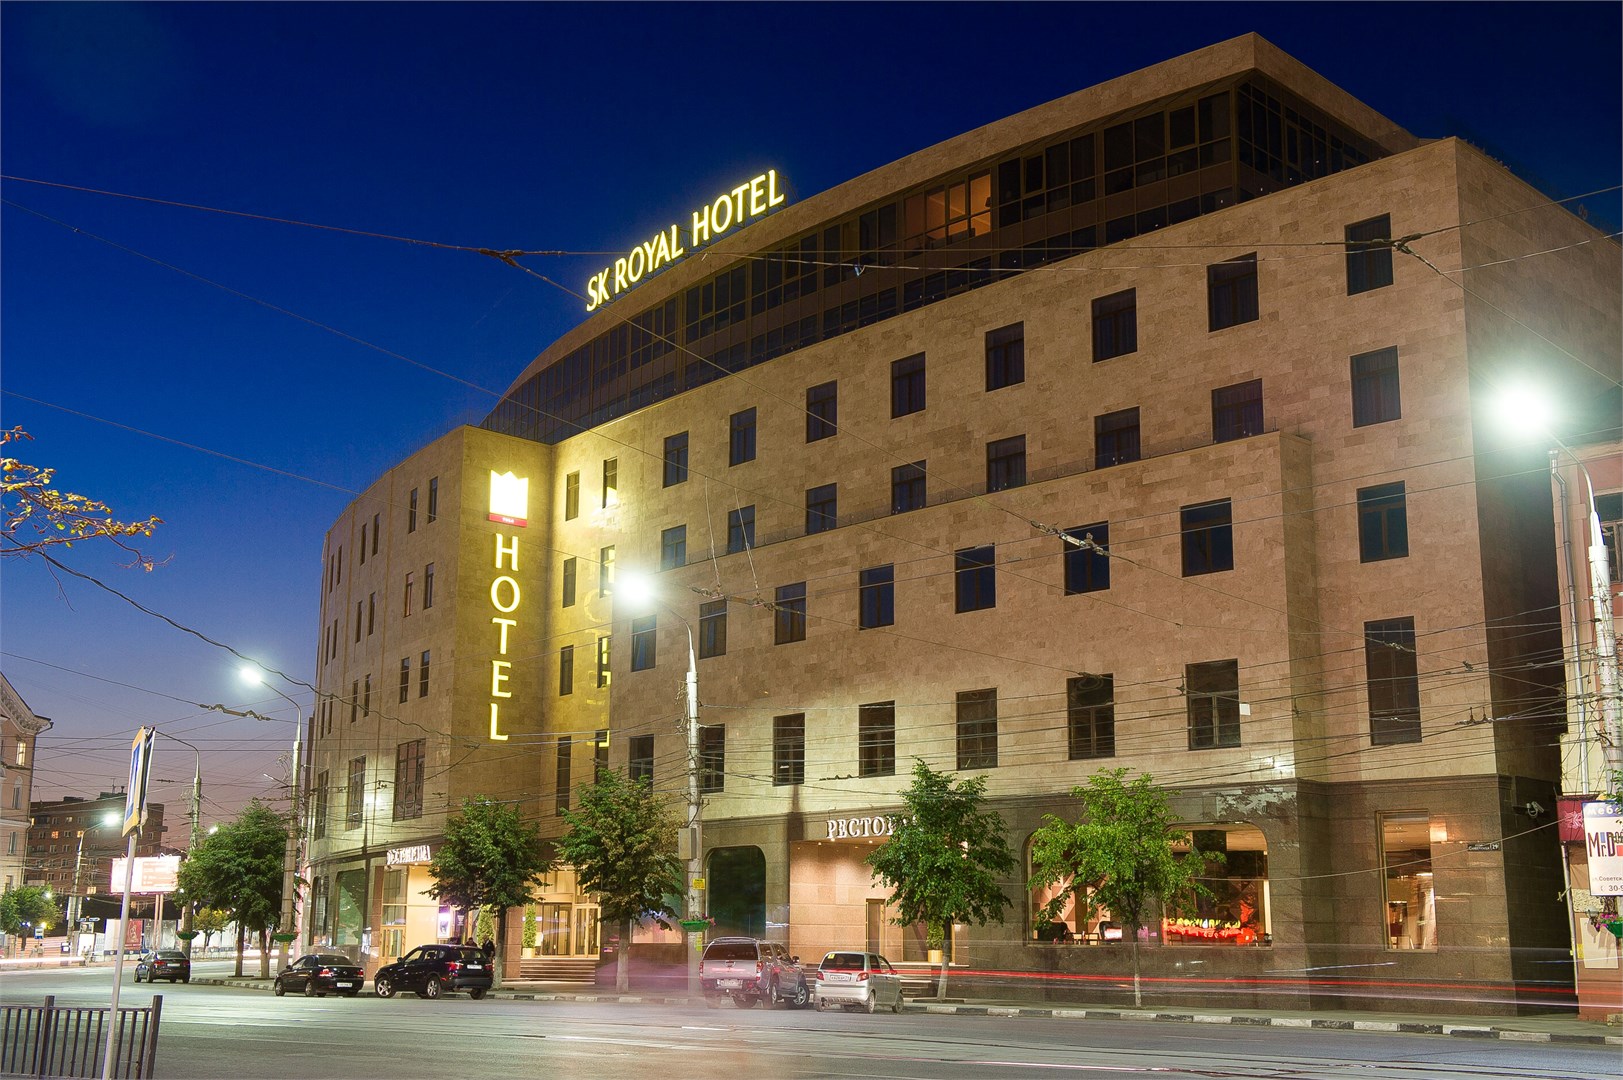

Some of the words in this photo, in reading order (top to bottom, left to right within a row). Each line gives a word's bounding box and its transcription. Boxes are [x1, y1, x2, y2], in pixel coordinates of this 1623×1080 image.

[587, 268, 610, 311] SK
[615, 225, 684, 293] ROYAL
[693, 170, 784, 247] HOTEL
[490, 533, 520, 741] HOTEL
